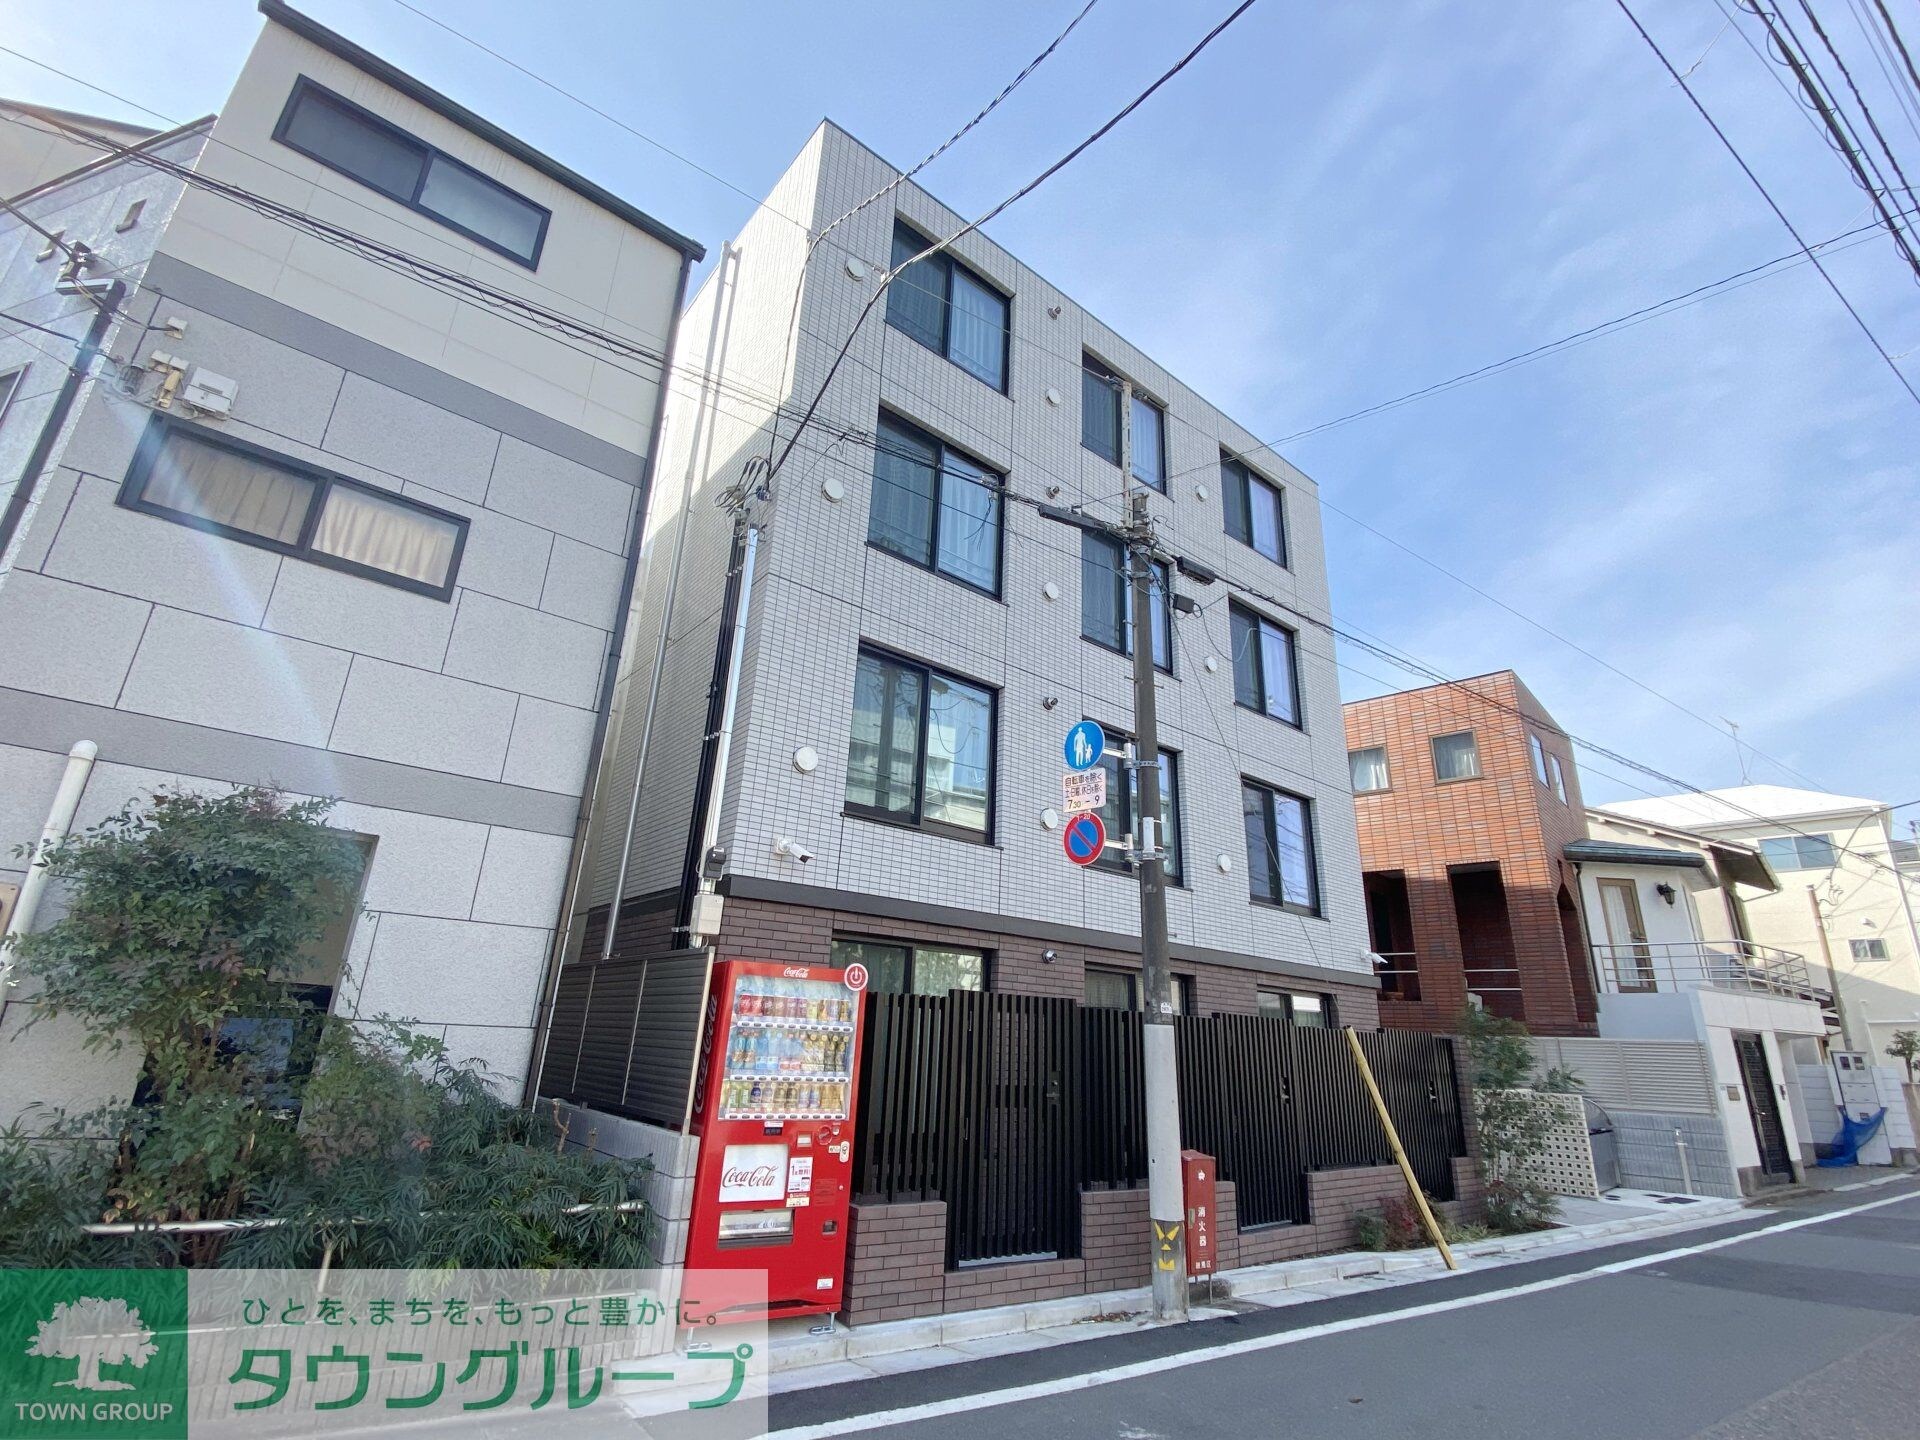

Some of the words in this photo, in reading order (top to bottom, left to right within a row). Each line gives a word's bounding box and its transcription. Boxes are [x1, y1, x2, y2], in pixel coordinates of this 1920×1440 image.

[783, 967, 810, 978] Coca-Cola
[694, 994, 717, 1114] Coca-Cola
[722, 1165, 779, 1188] Coca-Cola
